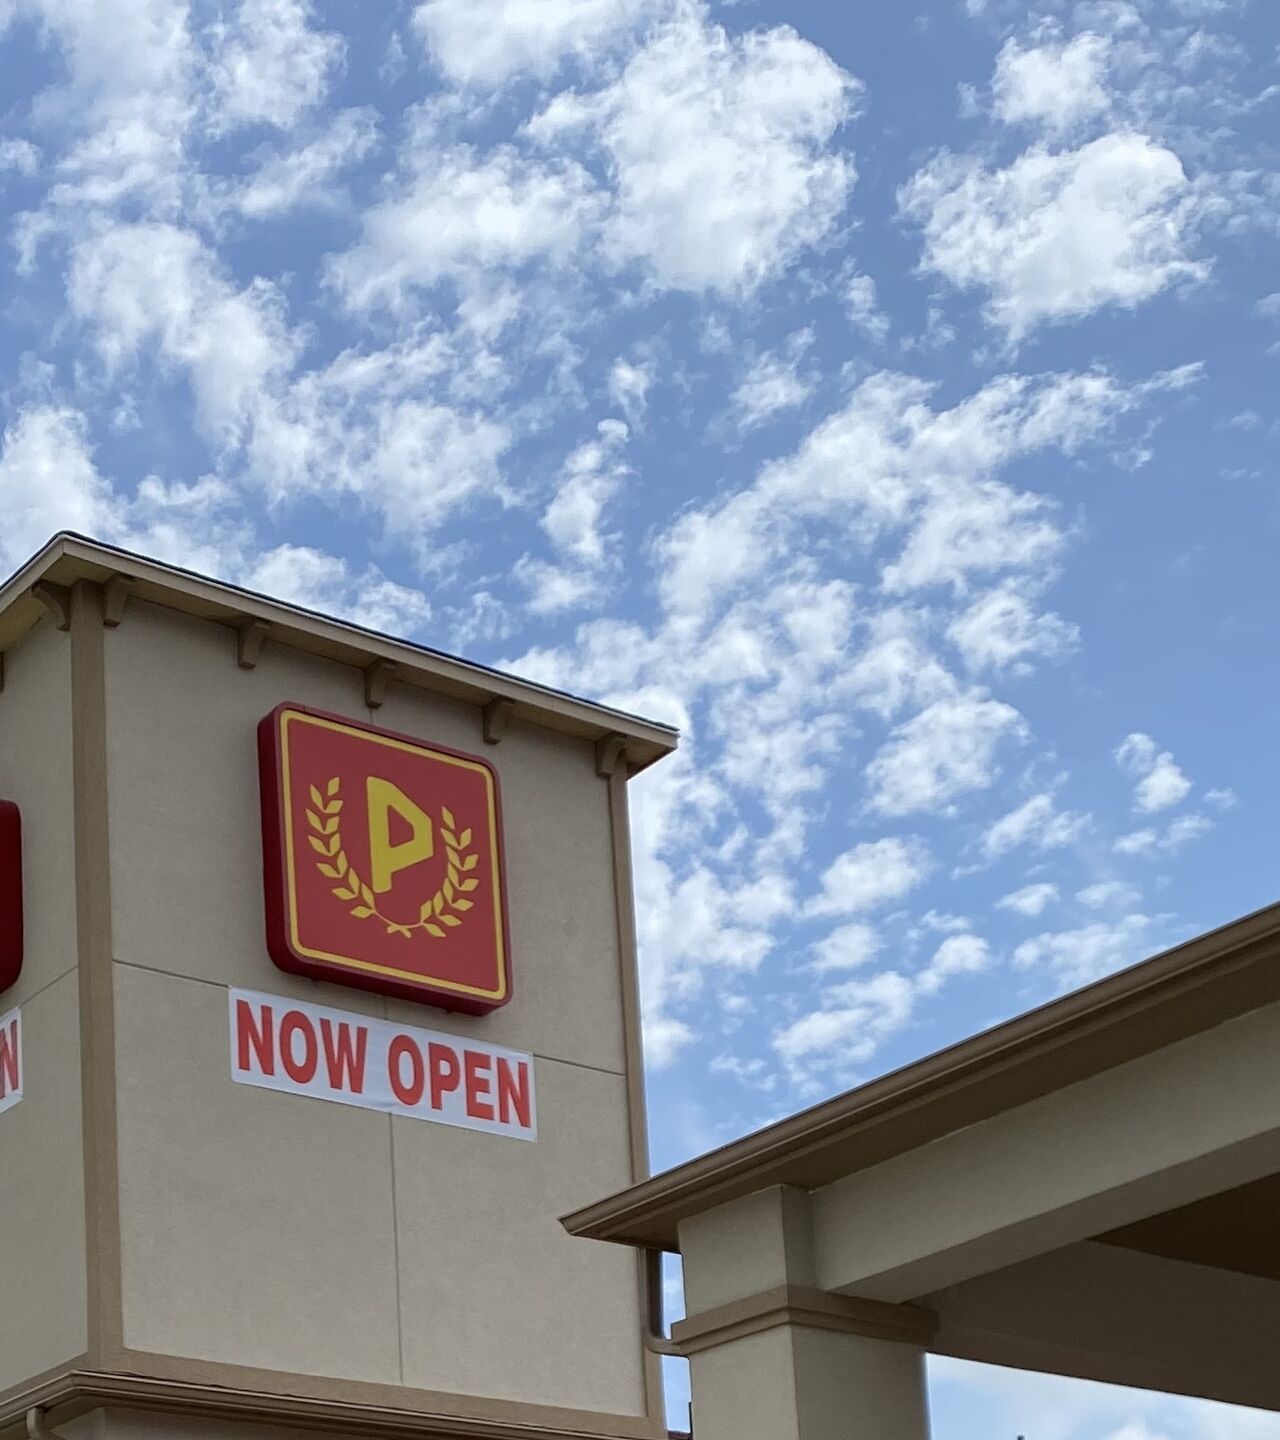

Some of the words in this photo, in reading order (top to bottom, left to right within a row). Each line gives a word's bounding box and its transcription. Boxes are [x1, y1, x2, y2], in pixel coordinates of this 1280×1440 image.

[366, 776, 433, 893] P
[236, 999, 368, 1094] NOW
[388, 1034, 532, 1128] OPEN
